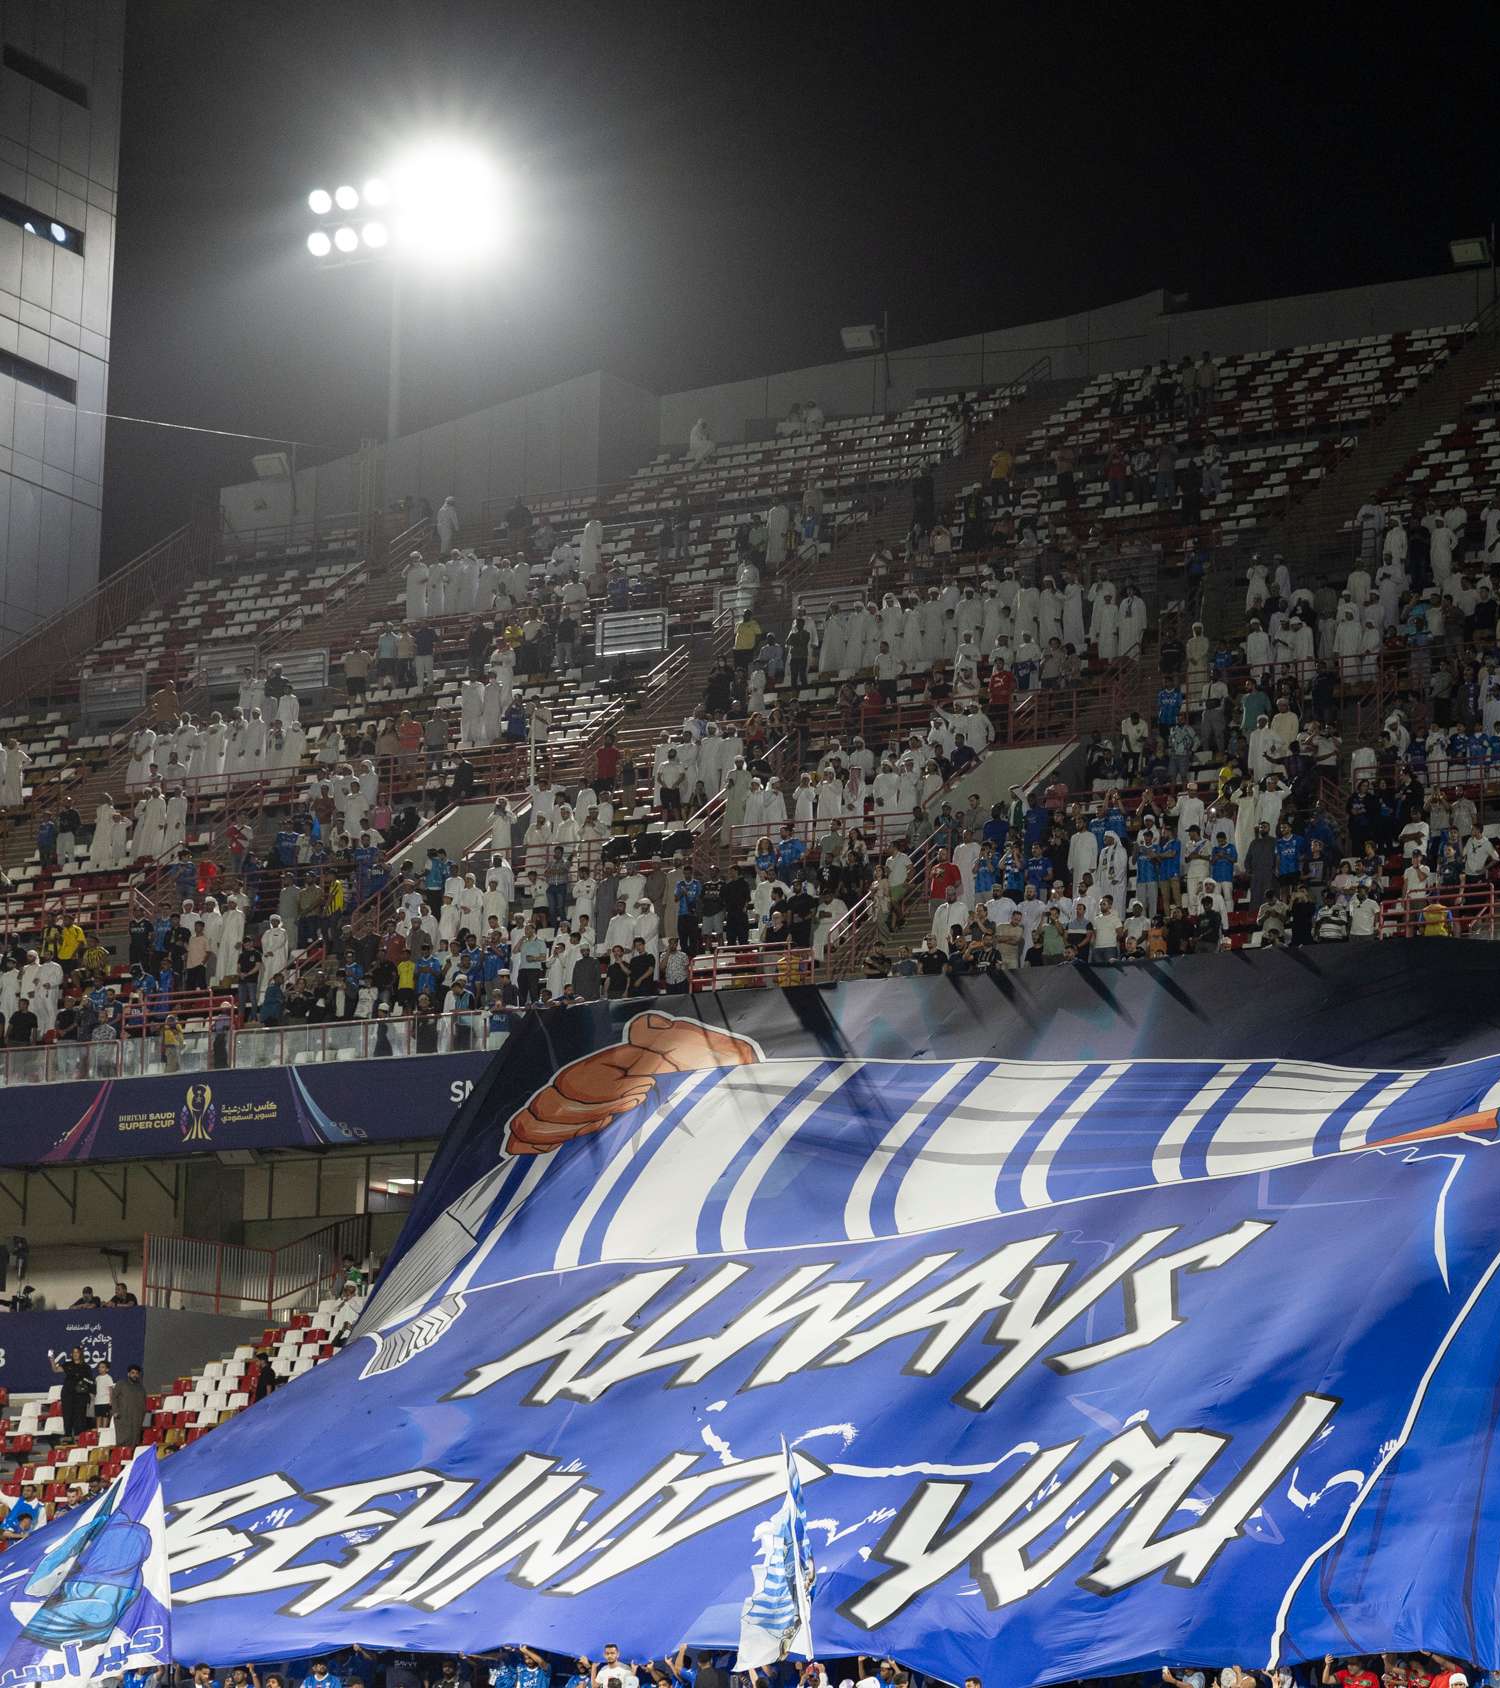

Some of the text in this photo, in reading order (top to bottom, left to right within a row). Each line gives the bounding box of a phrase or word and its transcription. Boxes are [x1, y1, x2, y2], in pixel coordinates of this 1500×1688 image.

[118, 1119, 175, 1131] SUPER CUP
[149, 1112, 175, 1120] SAUDI
[442, 1219, 1277, 1412] ALWAYS
[167, 1450, 832, 1617] BEHIND
[836, 1391, 1343, 1632] YOU
